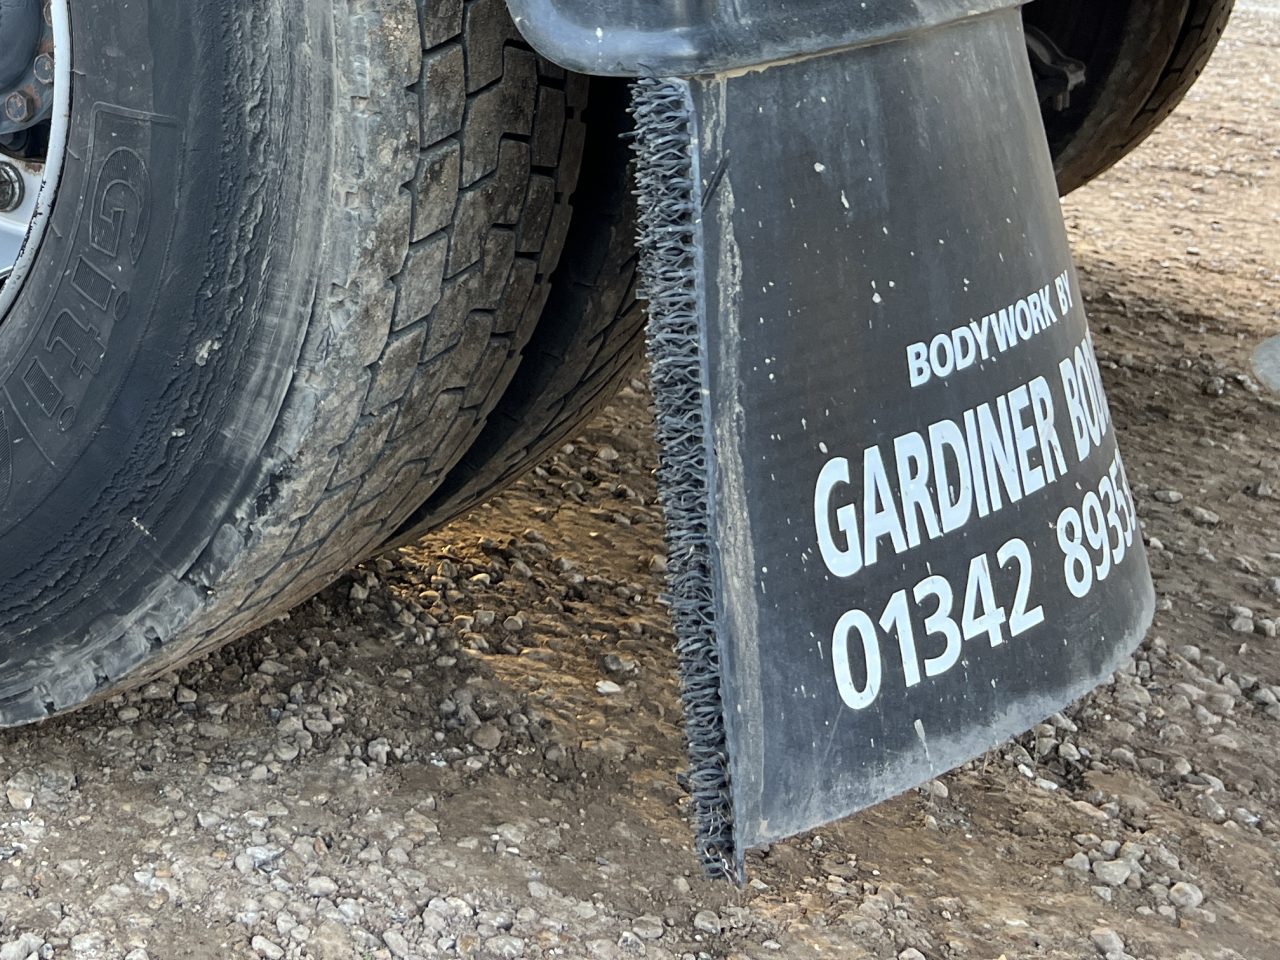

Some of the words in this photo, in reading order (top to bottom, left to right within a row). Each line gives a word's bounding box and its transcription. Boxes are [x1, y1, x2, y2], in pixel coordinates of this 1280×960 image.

[23, 146, 152, 432] Giti
[906, 284, 1057, 388] BODYWORK
[1054, 270, 1074, 317] BY
[813, 375, 1069, 578] GARDINER
[831, 537, 1046, 710] 01342
